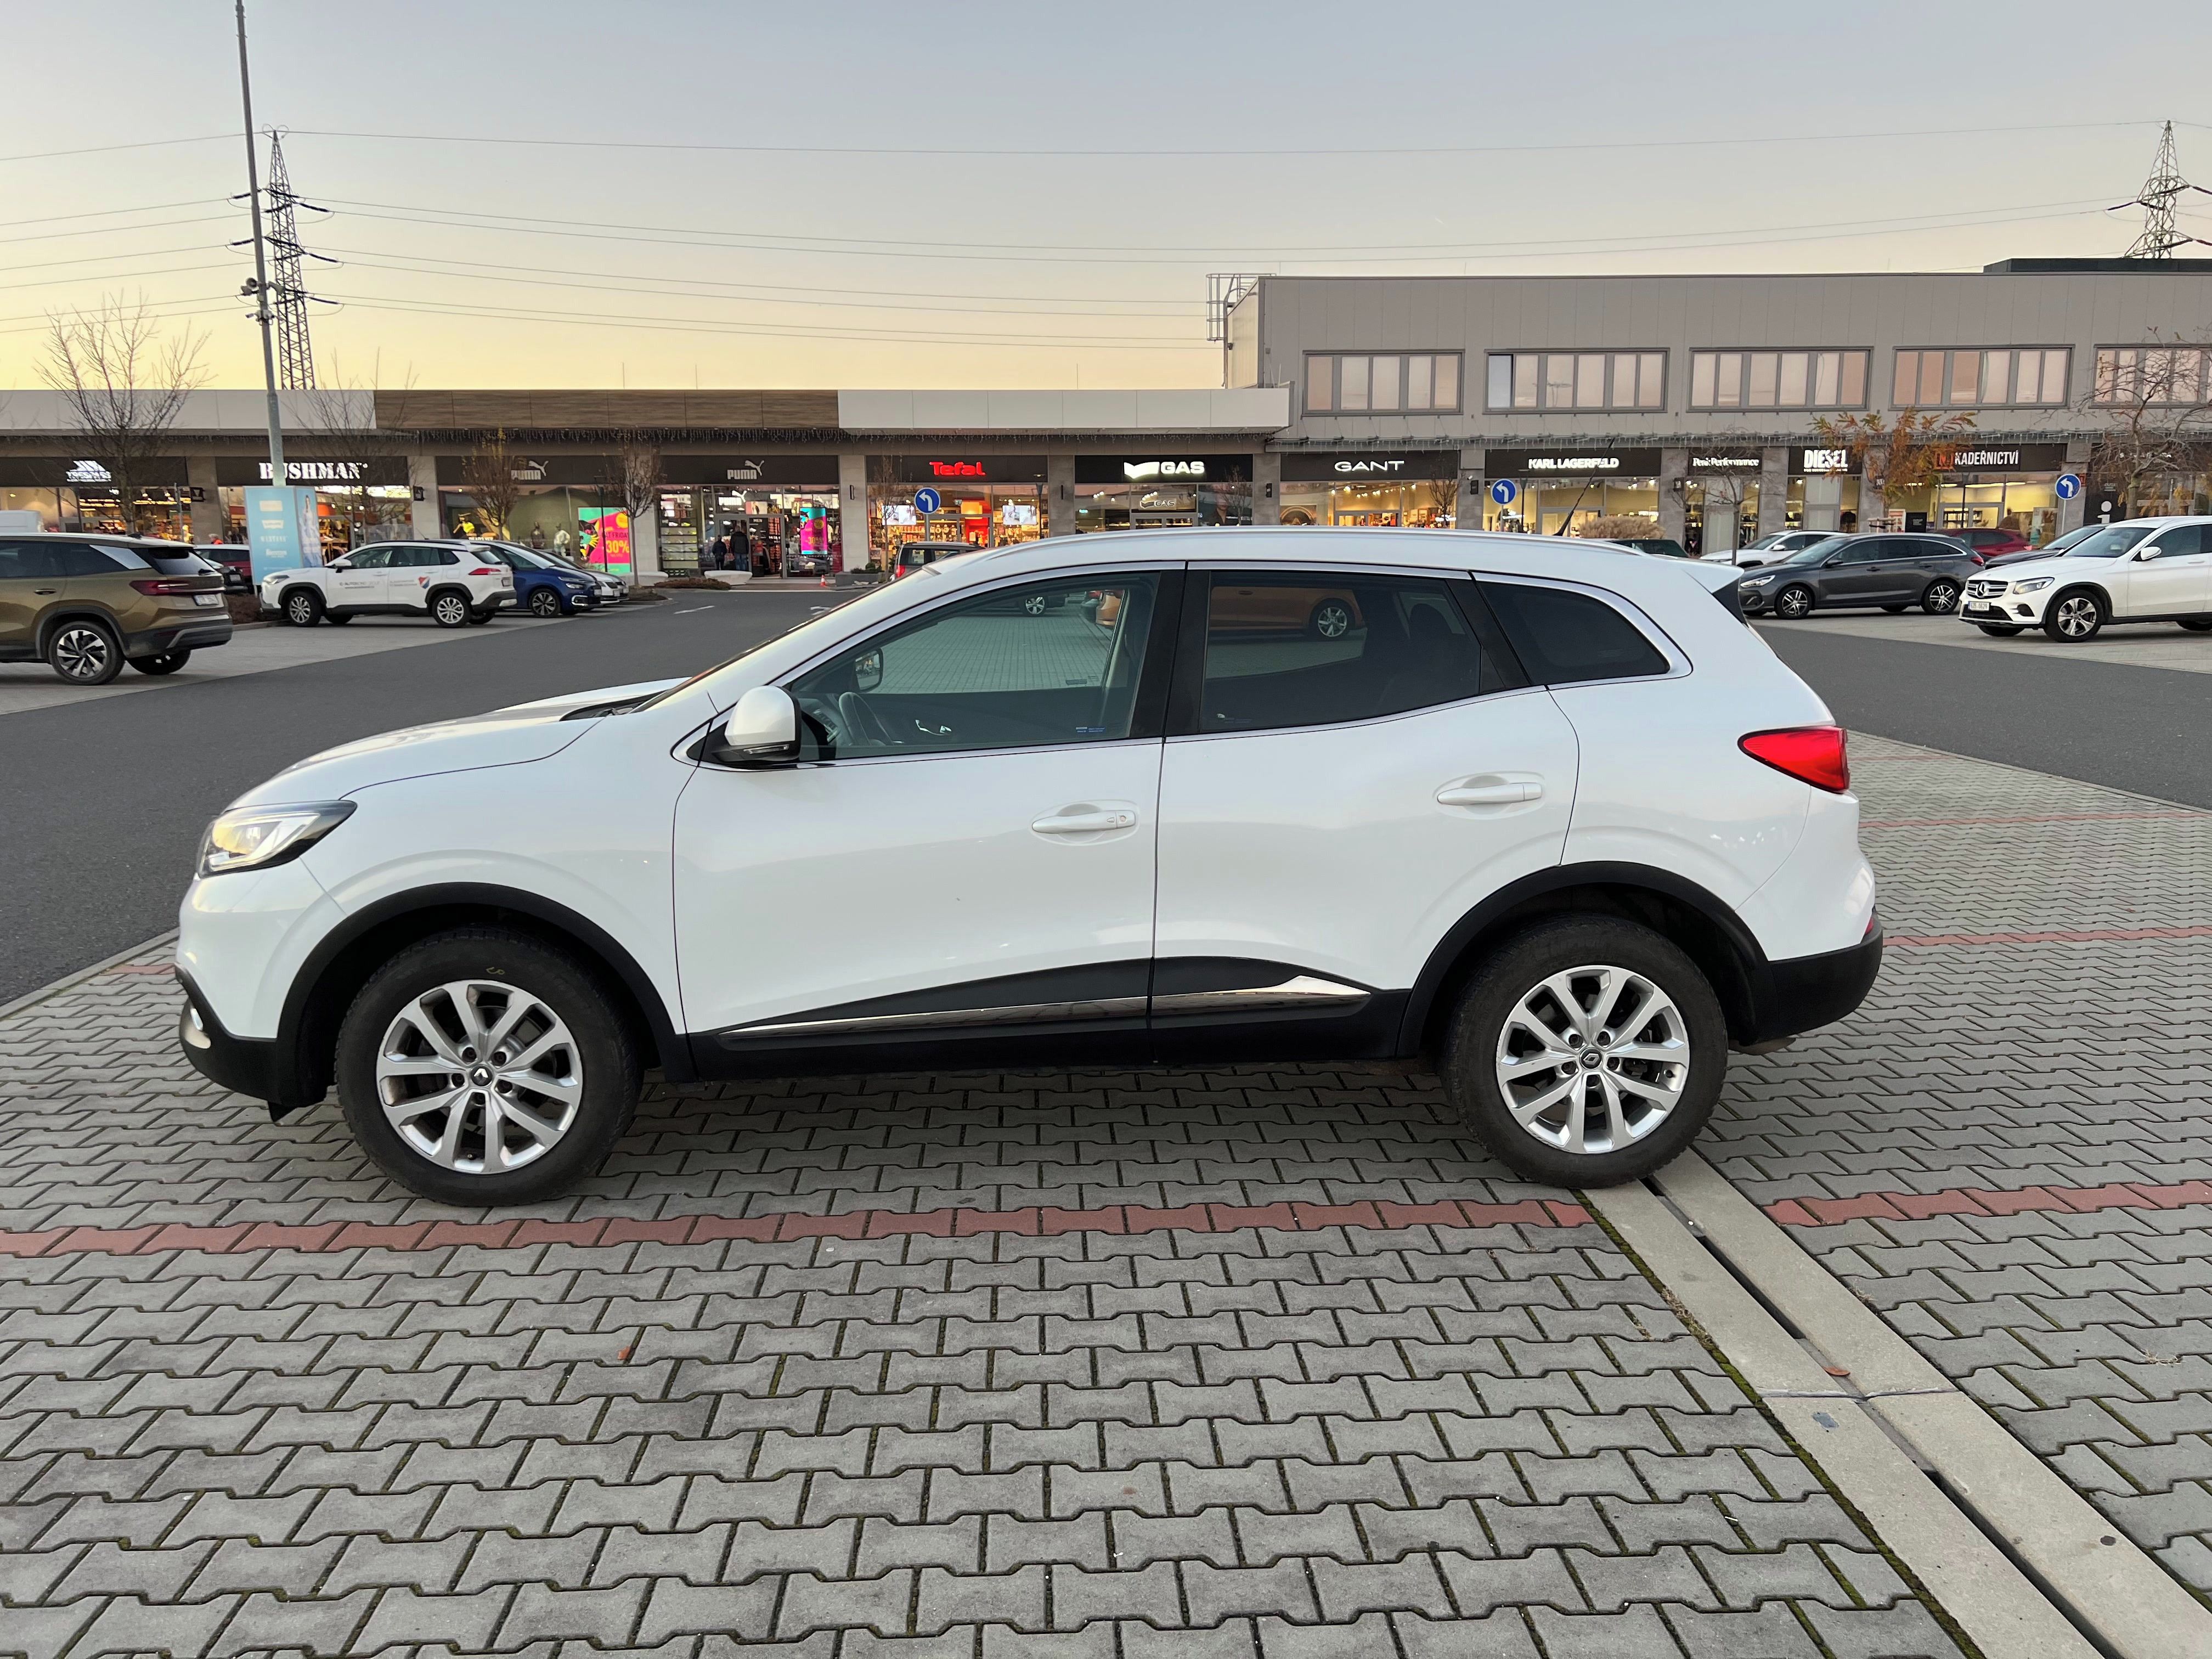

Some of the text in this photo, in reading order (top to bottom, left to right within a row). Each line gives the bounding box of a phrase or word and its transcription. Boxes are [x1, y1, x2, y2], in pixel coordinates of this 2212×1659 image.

[1528, 458, 1620, 469] KARL LAGERFELD
[1804, 449, 1848, 468] DIESEL
[1955, 450, 2019, 465] KADEŘNICTVÍ
[259, 462, 363, 479] BSHMAN
[929, 461, 986, 475] Tefal
[1160, 461, 1205, 474] GAS
[1334, 460, 1404, 471] GANT
[511, 470, 541, 479] PUMA
[727, 470, 757, 479] PUMA
